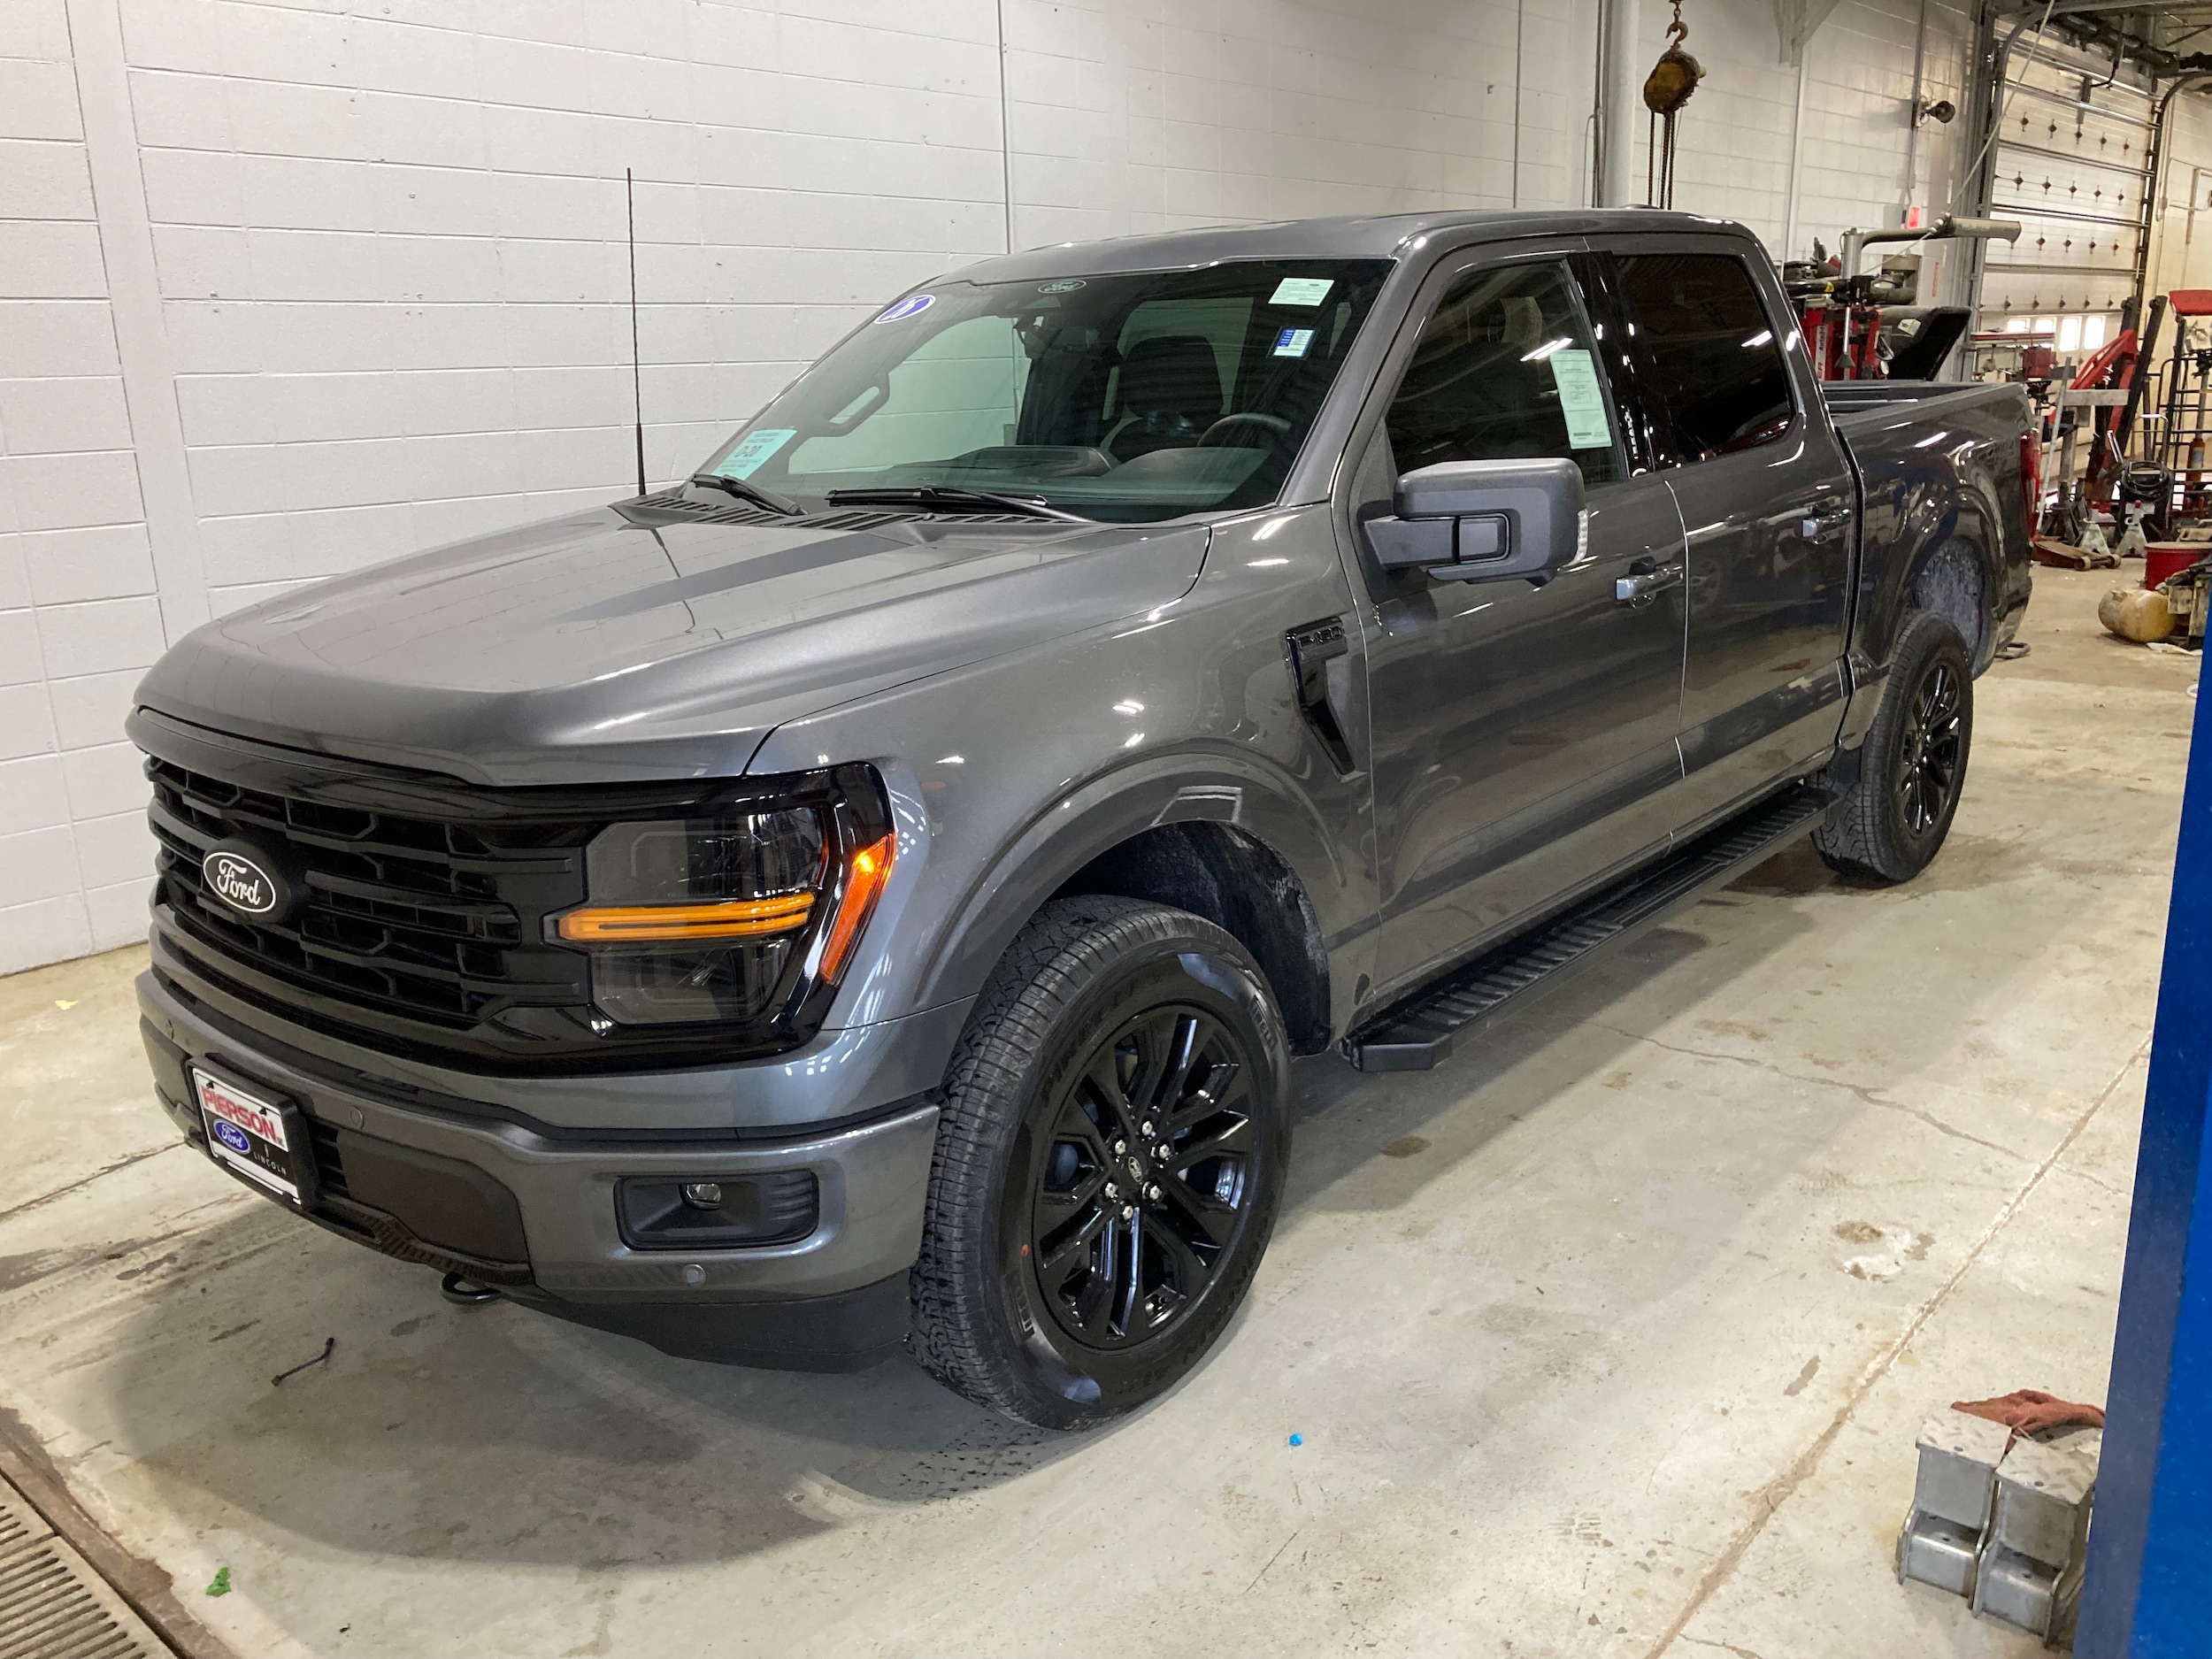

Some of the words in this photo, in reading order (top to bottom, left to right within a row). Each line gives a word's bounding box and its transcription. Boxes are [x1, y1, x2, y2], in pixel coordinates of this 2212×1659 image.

[217, 858, 260, 905] Ford
[201, 1086, 277, 1143] PIERSON
[220, 1123, 243, 1148] Ford
[253, 1152, 287, 1175] LINCOLN
